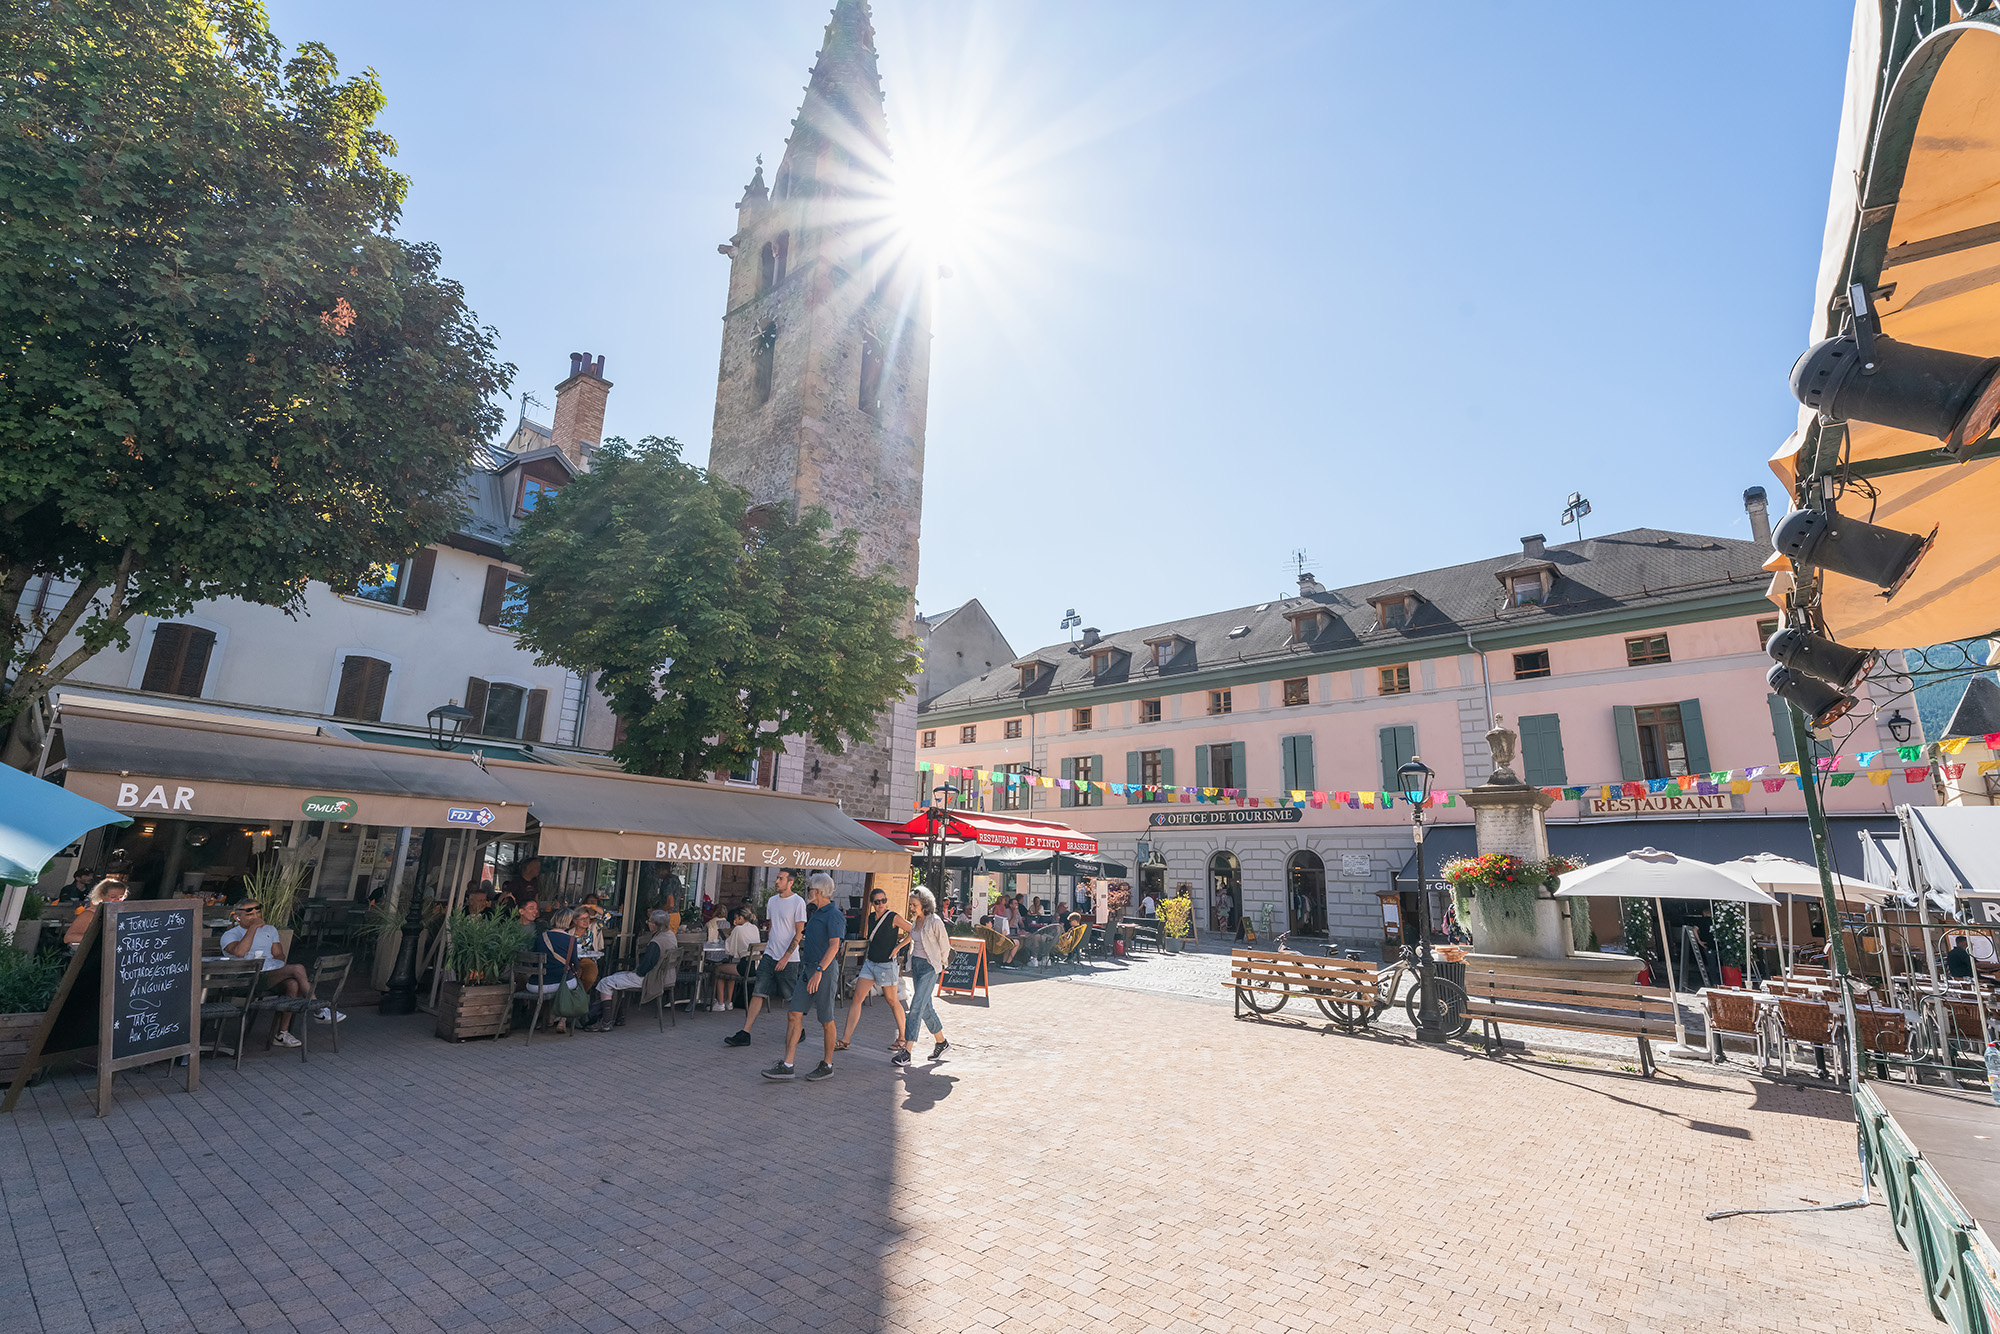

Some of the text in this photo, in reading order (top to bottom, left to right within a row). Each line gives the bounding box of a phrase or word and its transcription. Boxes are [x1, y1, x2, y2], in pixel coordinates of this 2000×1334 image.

[117, 782, 195, 811] BAR
[1593, 795, 1725, 812] RESTAURANT
[306, 802, 333, 813] PMU
[450, 810, 474, 821] FDJ
[1168, 809, 1293, 825] OFFICE DE TOURISME
[978, 833, 1096, 852] RESTAURANT LE TINTO BRASSERIE
[655, 841, 842, 868] BRASSERIE Le Manuel
[1435, 882, 1452, 891] Gla
[154, 936, 172, 949] DE
[126, 1011, 159, 1027] TARTE
